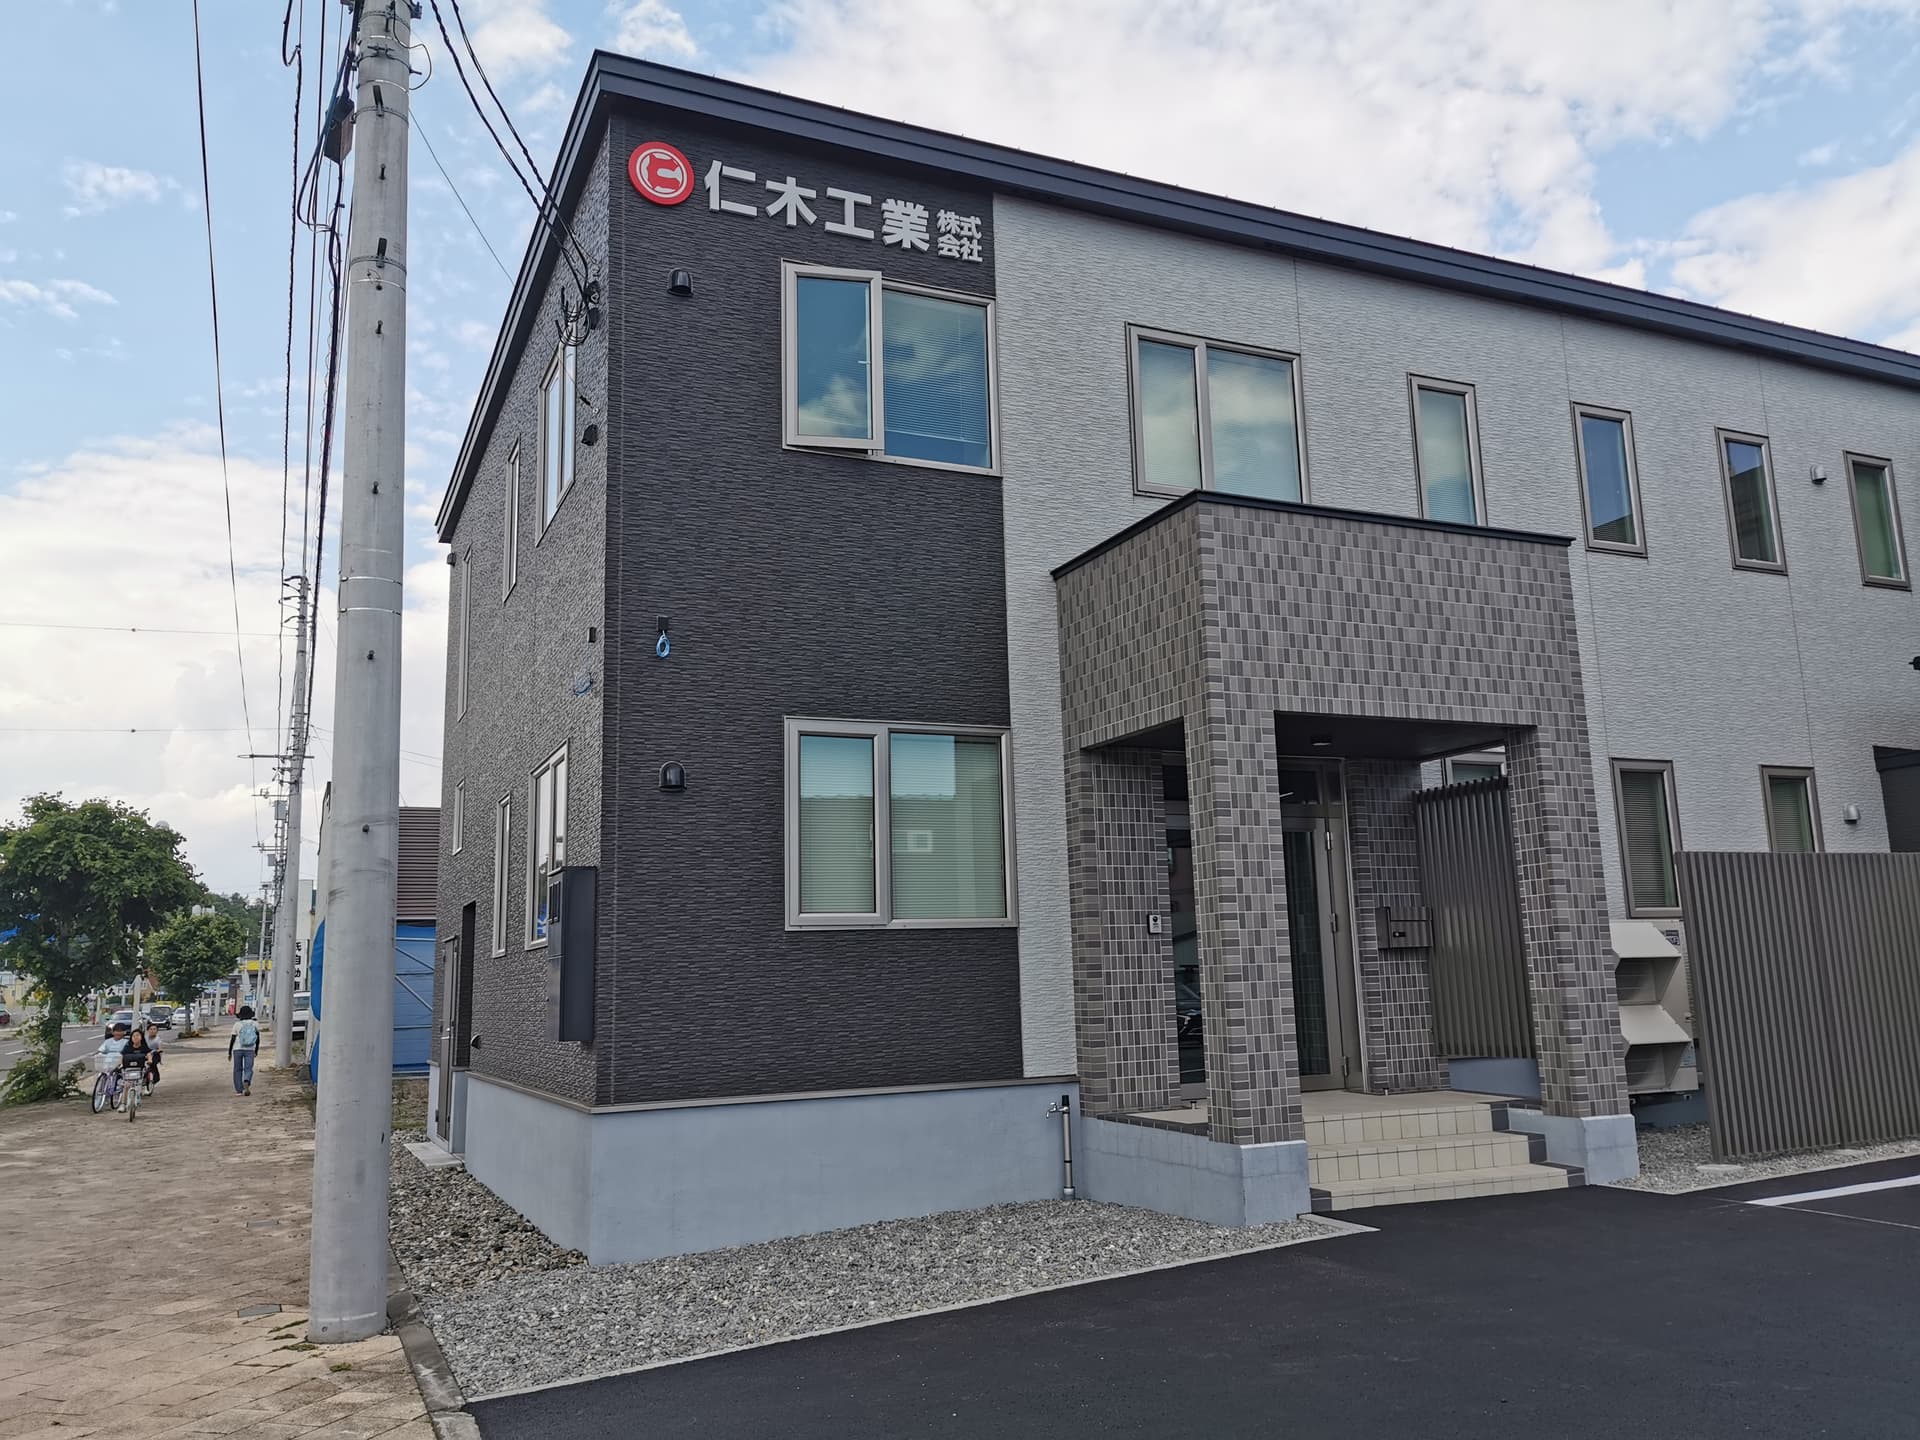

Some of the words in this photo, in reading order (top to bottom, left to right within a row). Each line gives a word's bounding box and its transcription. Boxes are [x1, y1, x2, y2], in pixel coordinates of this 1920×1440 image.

[704, 160, 930, 251] 仁木工業
[936, 209, 982, 239] 株式
[937, 233, 983, 262] 会社
